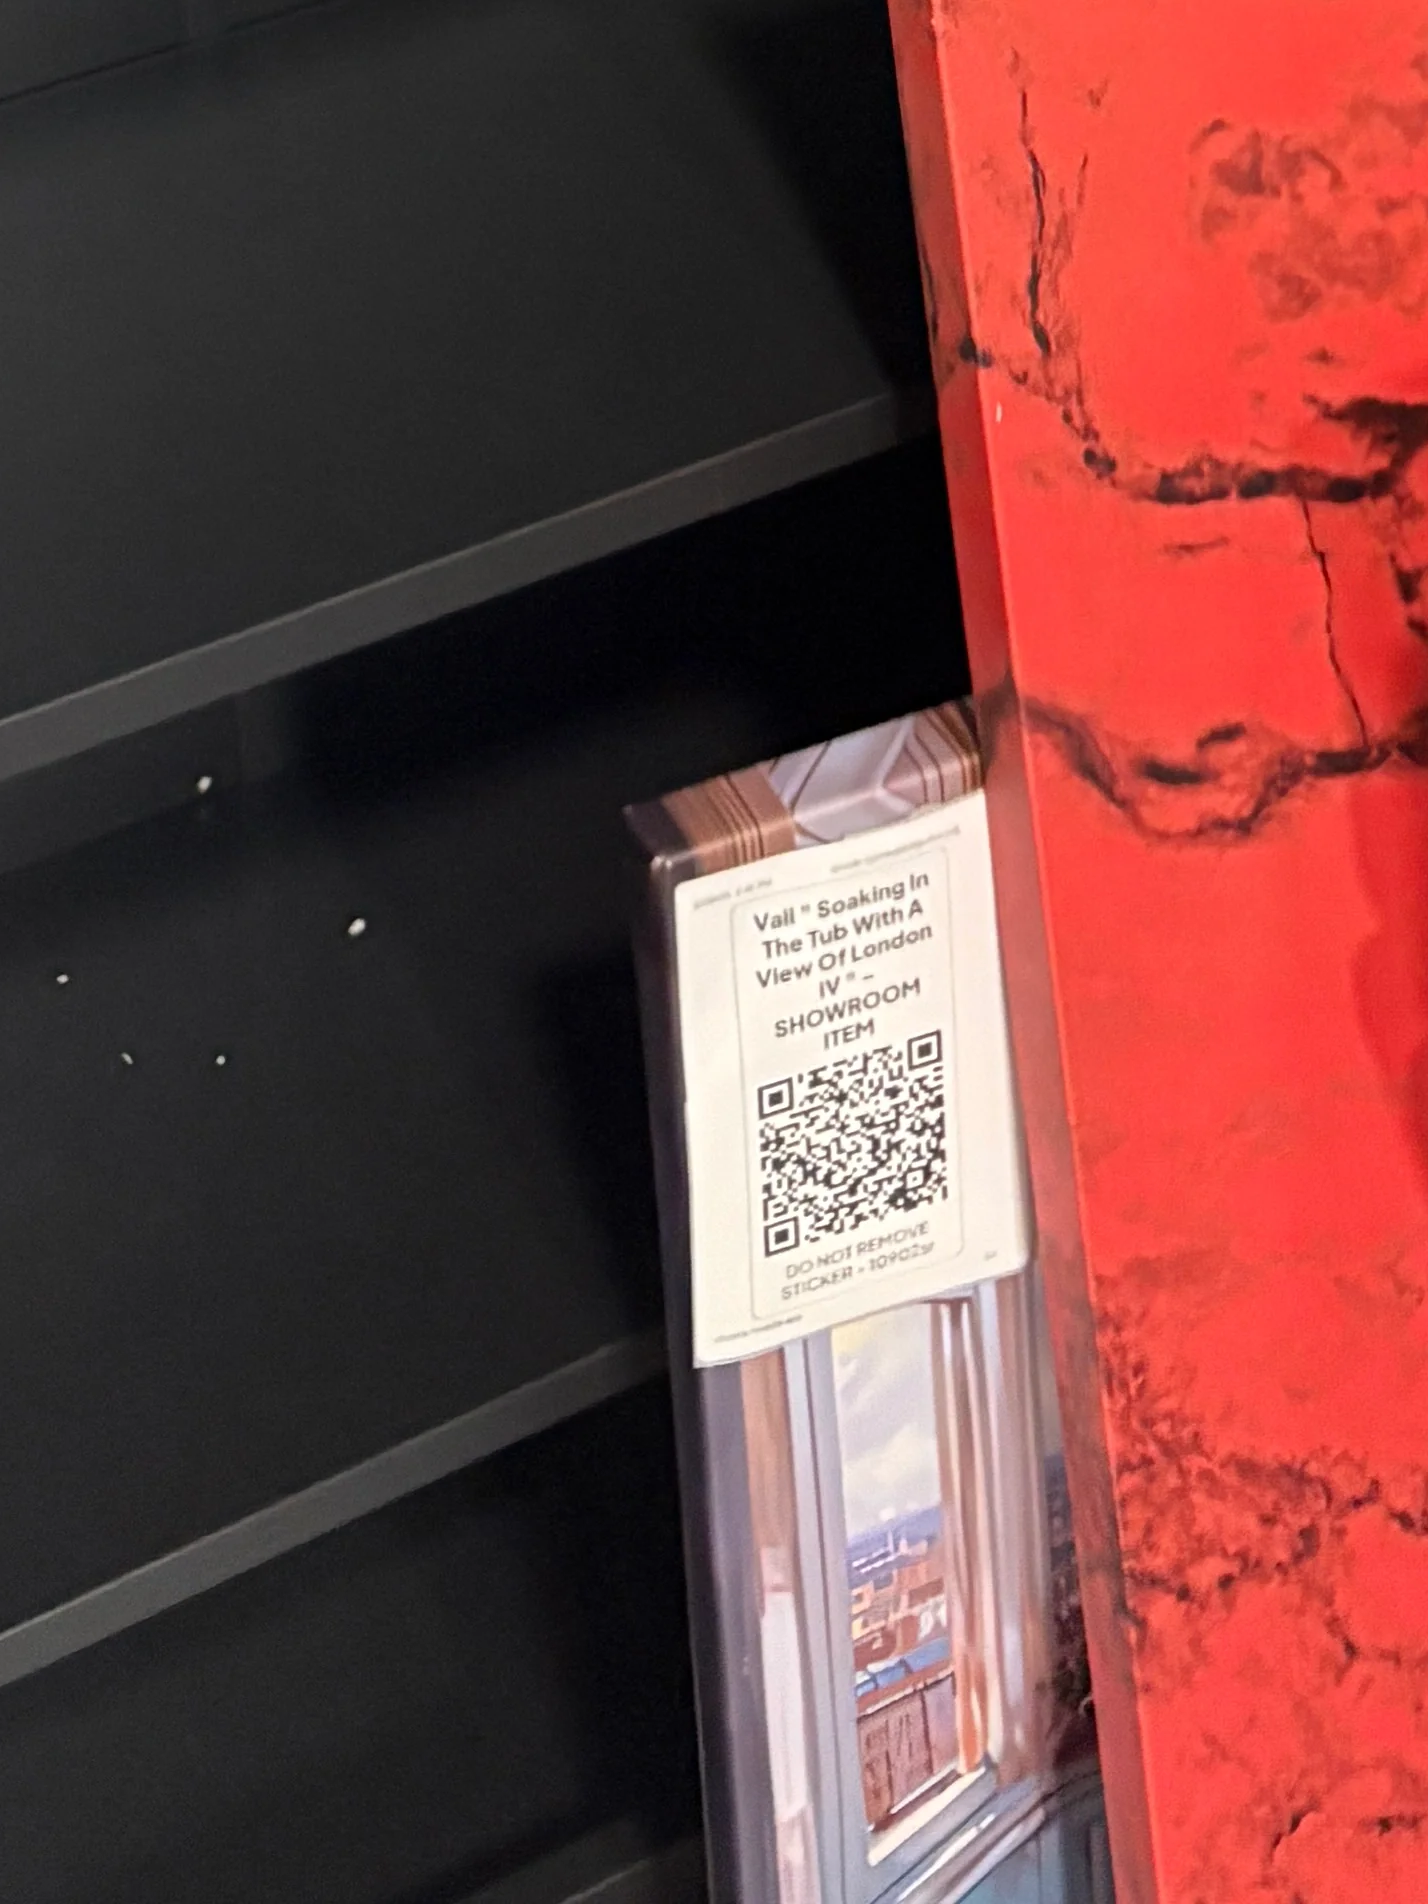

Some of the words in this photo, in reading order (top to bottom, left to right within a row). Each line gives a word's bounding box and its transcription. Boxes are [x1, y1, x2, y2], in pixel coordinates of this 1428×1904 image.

[817, 880, 906, 919] Soaking
[909, 872, 930, 892] In
[755, 961, 814, 989] View
[818, 947, 847, 971] Of
[851, 923, 934, 964] London
[761, 936, 804, 961] The
[808, 923, 849, 949] Tub
[851, 907, 905, 936] With
[907, 898, 924, 919] A
[774, 976, 922, 1039] SHOWROOM
[818, 975, 842, 1000] IV
[822, 1018, 876, 1050] ITEM
[785, 1259, 814, 1279] DO
[817, 1245, 853, 1269] NOT
[856, 1220, 930, 1257] REMOVE
[781, 1265, 854, 1301] STICKER
